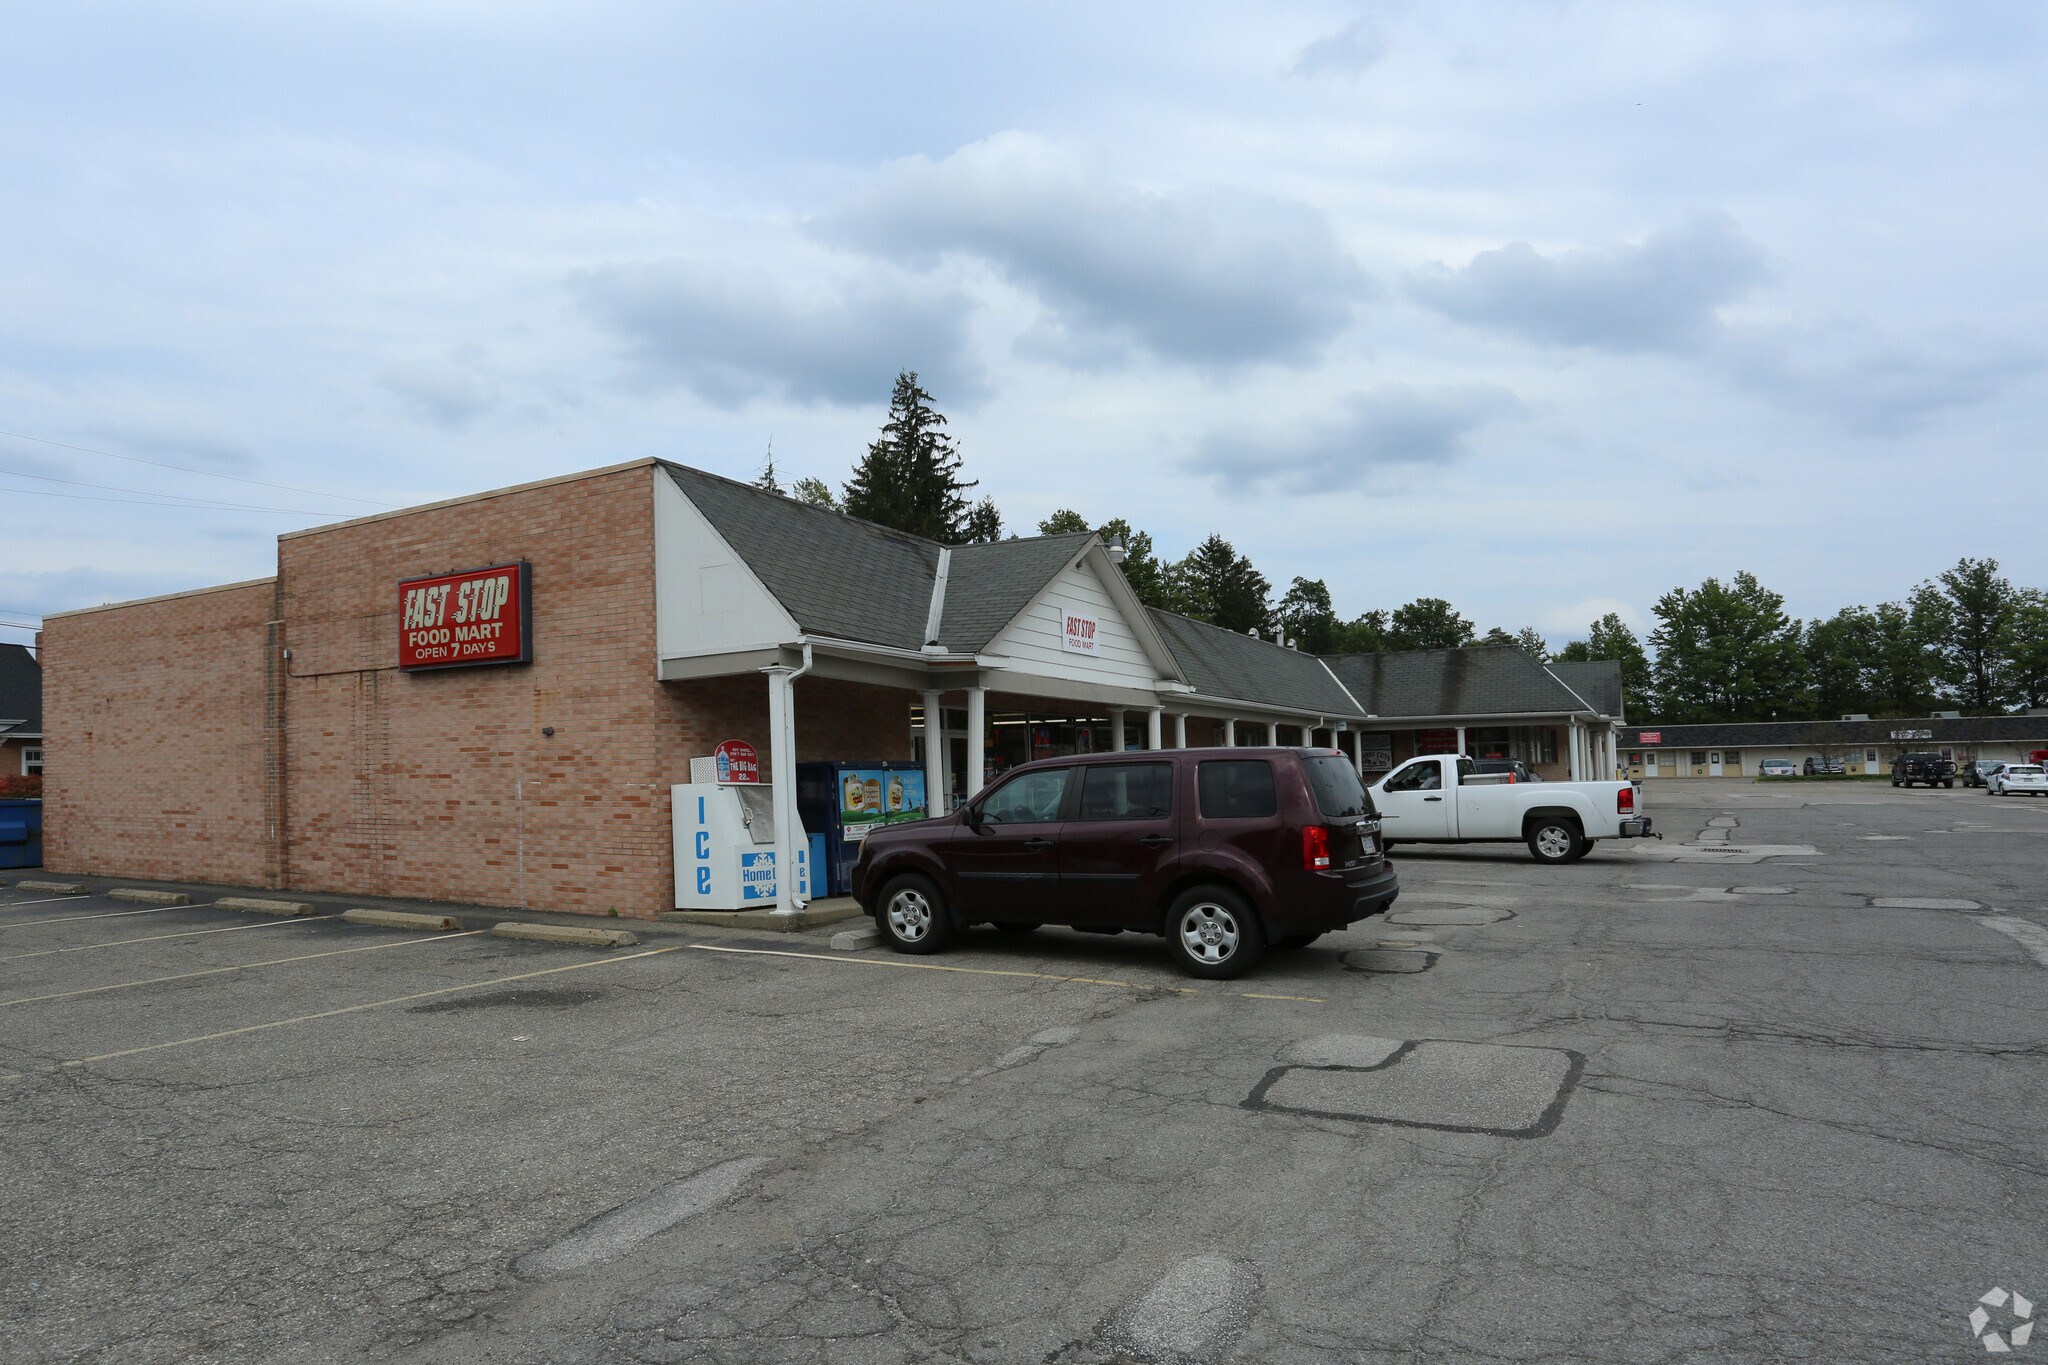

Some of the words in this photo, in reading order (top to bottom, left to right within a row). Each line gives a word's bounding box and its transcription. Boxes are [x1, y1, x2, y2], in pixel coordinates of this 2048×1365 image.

[403, 585, 451, 630] FAST
[451, 576, 509, 623] STOP
[409, 629, 450, 647] FOOD
[455, 622, 503, 642] MART
[1066, 616, 1081, 636] FAST
[1081, 619, 1096, 639] STOP
[415, 646, 447, 659] OPEN
[450, 643, 460, 657] 7
[463, 641, 496, 655] DAYS
[1068, 638, 1081, 648] FOOD
[1082, 640, 1094, 650] MART
[1376, 752, 1390, 761] CUTS
[742, 869, 772, 882] Home
